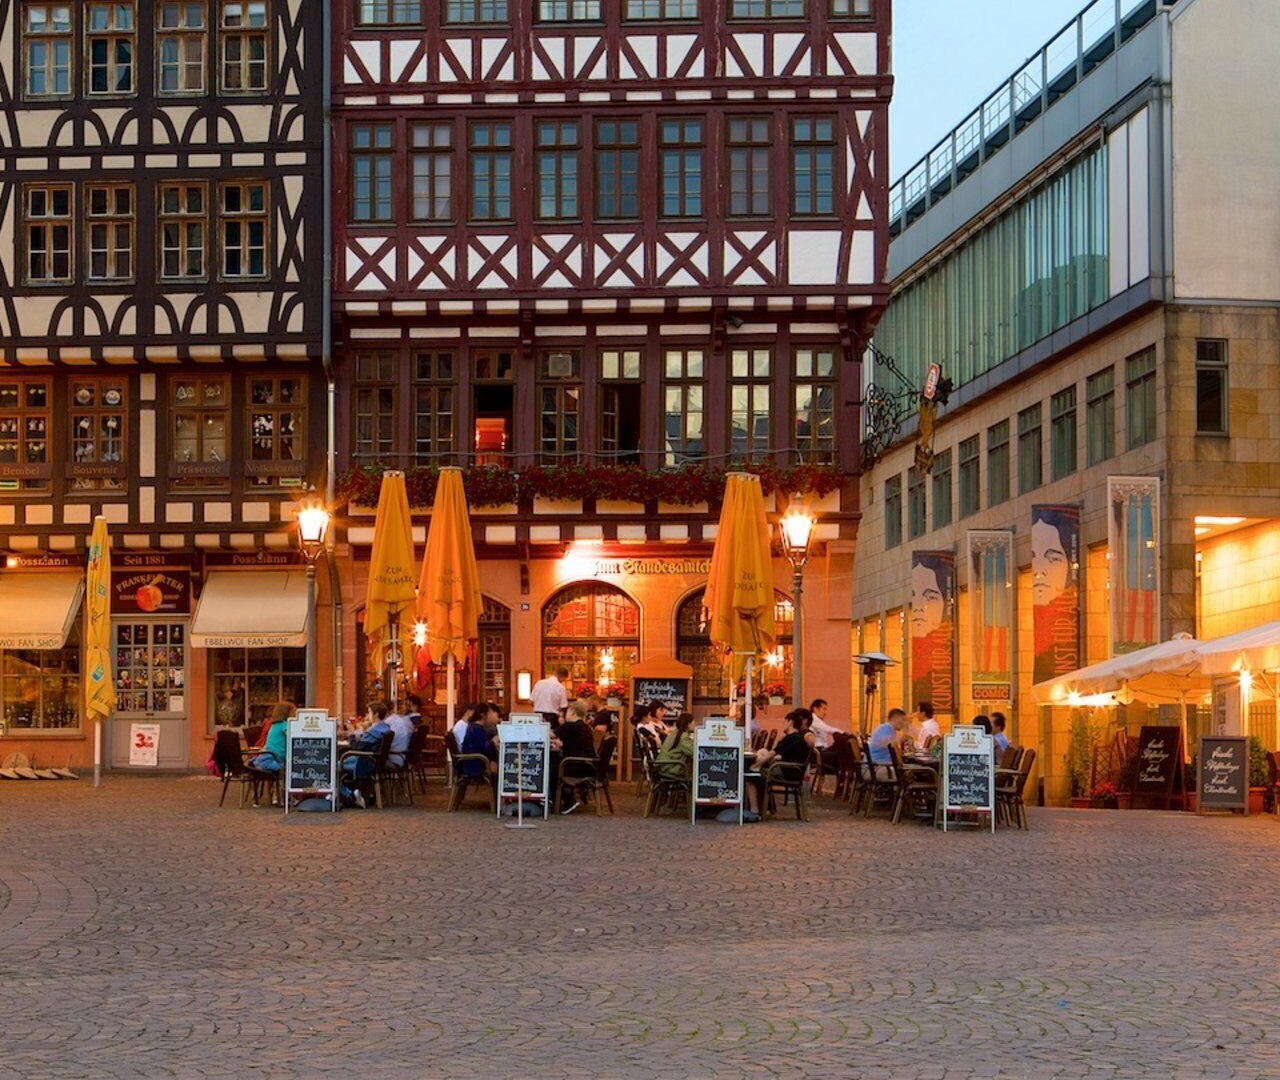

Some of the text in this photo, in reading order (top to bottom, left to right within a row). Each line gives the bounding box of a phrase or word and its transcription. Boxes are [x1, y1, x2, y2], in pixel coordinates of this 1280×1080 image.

[2, 466, 40, 475] Bembel
[73, 465, 119, 475] Souvenir
[123, 555, 142, 565] Seit
[115, 574, 185, 592] FRANKFTER
[18, 639, 34, 647] FAN
[39, 639, 59, 648] SHOP
[204, 637, 289, 646] EBBELWOI FAN SHOP
[931, 672, 953, 710] KUNST
[974, 688, 1009, 698] COMIC
